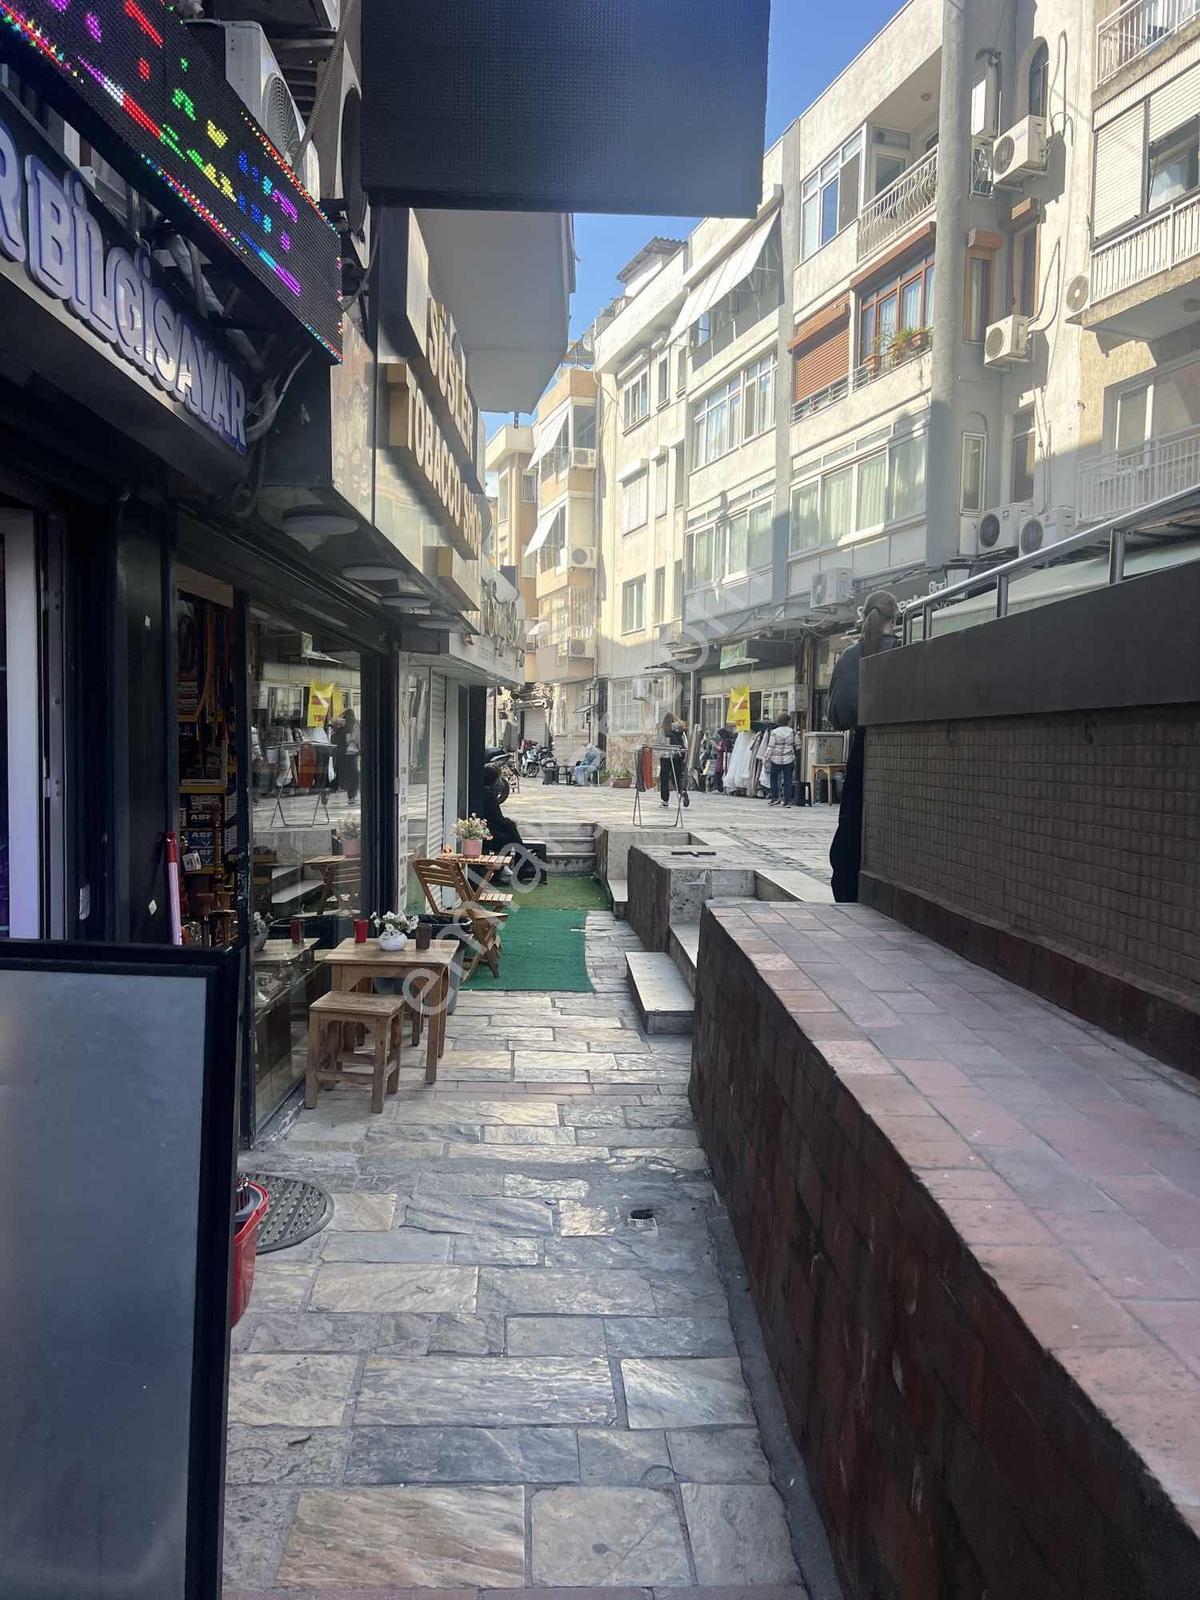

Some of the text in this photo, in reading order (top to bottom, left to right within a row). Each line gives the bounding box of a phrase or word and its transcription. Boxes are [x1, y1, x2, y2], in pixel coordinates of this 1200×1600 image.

[27, 157, 247, 448] BİLGİSAYAR
[428, 297, 474, 463] SÜSLER
[406, 363, 483, 560] TOBACCO SHOP
